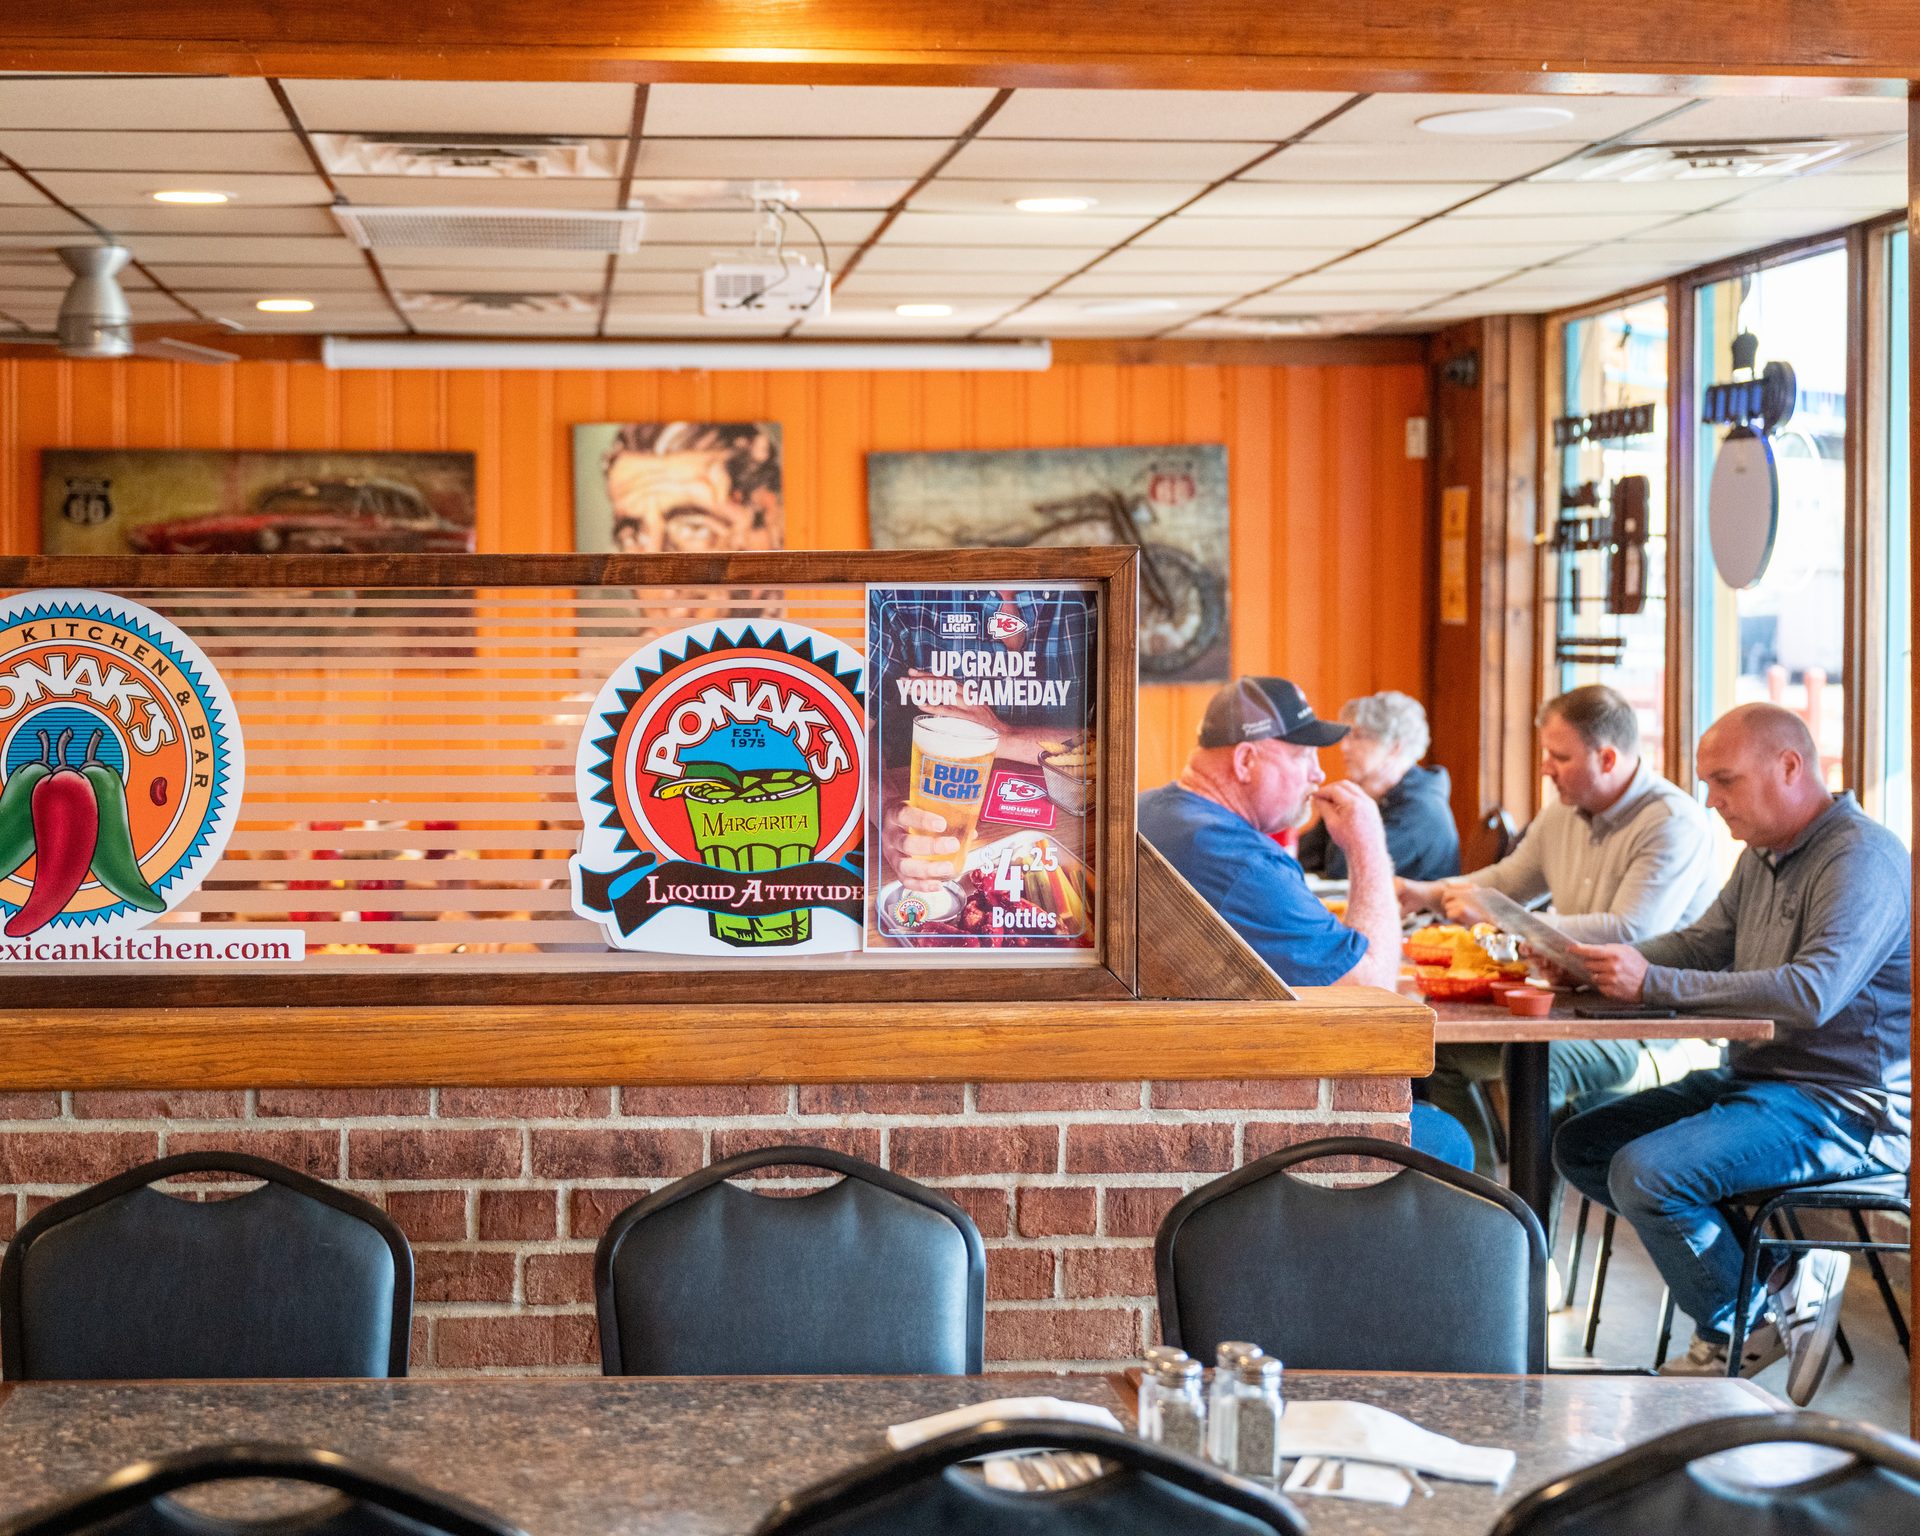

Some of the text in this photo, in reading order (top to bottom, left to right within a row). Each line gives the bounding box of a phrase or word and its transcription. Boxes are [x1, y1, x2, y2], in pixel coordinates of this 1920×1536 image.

[942, 623, 976, 633] LIGHT
[947, 614, 972, 624] BUD
[931, 650, 1037, 678] UPGRADE
[896, 679, 1071, 706] YOUR GAMEDAY
[21, 623, 209, 787] KITCHEN & BAR
[731, 738, 766, 748] 1975
[732, 728, 764, 738] EST.
[933, 764, 979, 784] BUD
[923, 777, 982, 800] LIGHT
[1000, 804, 1017, 812] BUD
[992, 906, 1057, 929] Bottles
[0, 936, 291, 961] xicankitchen.com
